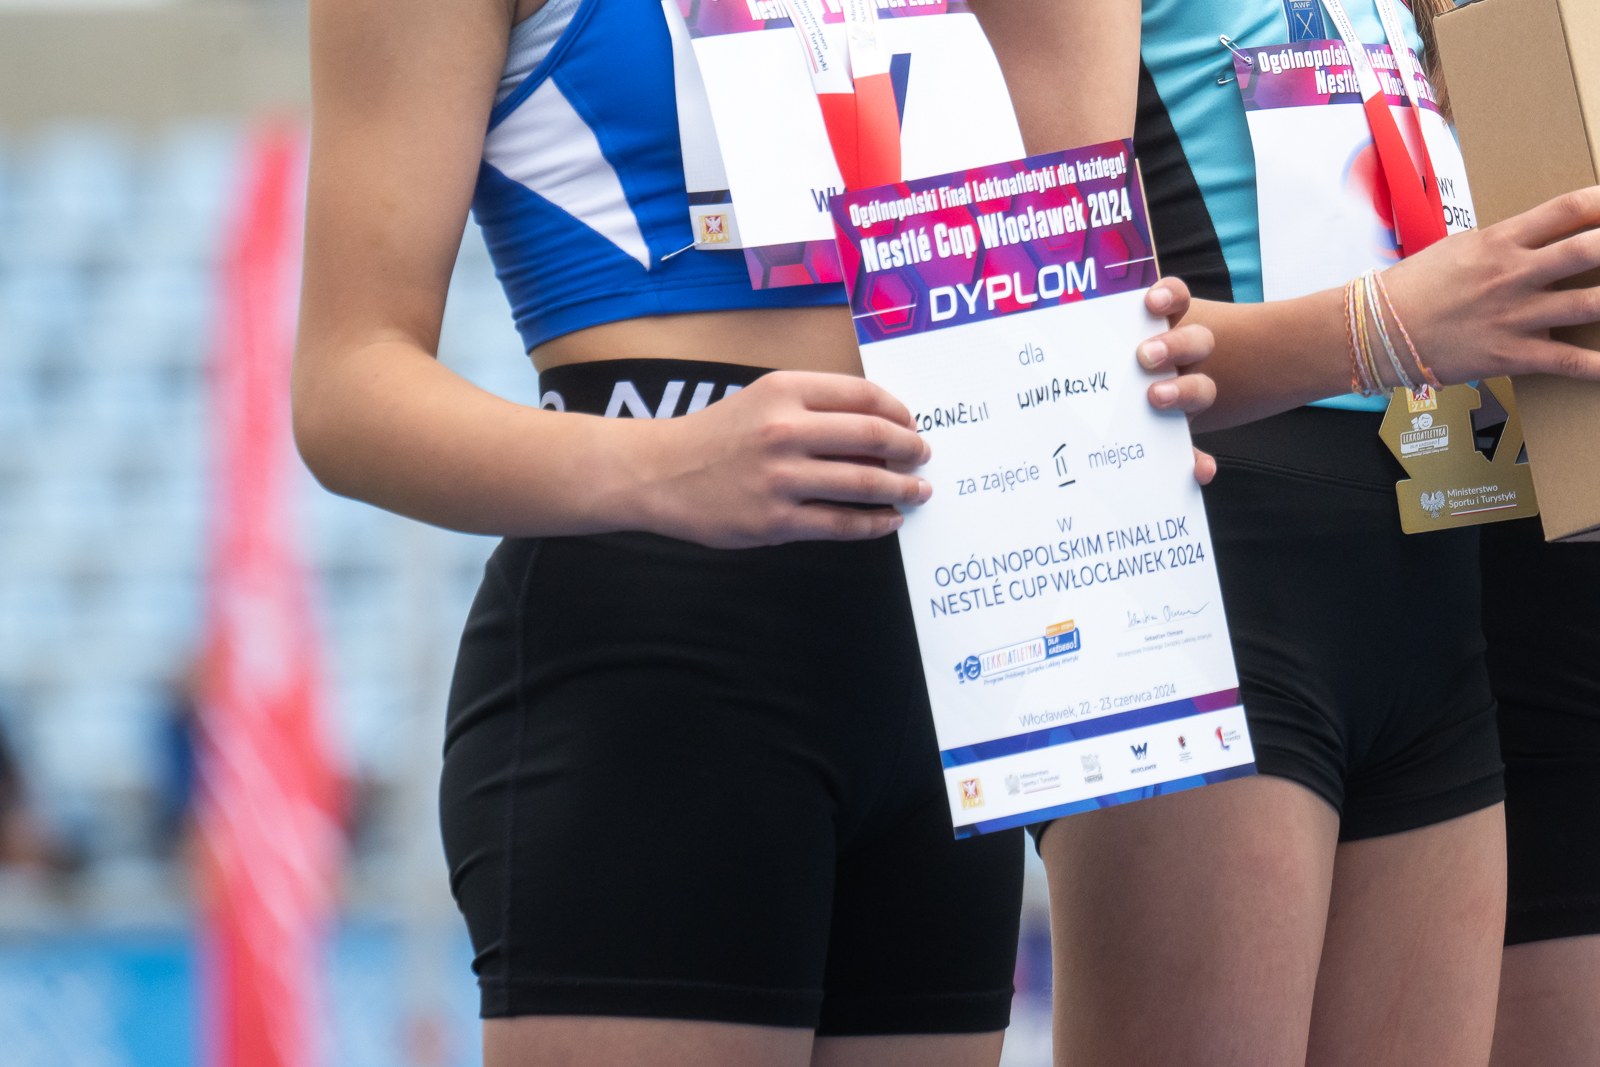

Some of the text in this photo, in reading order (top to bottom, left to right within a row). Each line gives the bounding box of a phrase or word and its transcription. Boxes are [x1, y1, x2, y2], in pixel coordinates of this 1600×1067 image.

[849, 193, 939, 227] Ogólnopolski
[939, 184, 973, 211] Finał
[973, 168, 1057, 202] Lekkoatletyki
[1057, 166, 1076, 186] dla
[1076, 152, 1127, 185] każdego!
[860, 187, 1132, 273] Nestlé Cup Włocławek 2024
[1442, 206, 1472, 229] ORZE
[929, 257, 1098, 323] DYPLOM
[1018, 343, 1045, 367] dla
[1017, 371, 1109, 409] WINIARCZYK
[1409, 400, 1435, 411] PZLA
[1403, 427, 1446, 443] LEKKOATLETYKA
[956, 479, 978, 496] za
[980, 462, 1040, 492] zajęcie
[1087, 440, 1146, 471] miejsca
[1447, 485, 1498, 498] Ministerstwo
[1448, 491, 1516, 509] Sportu i Turystyki
[934, 516, 1189, 588] OGÓLNOPOLSKIM FINAŁ LDK
[930, 542, 1205, 618] NESTLÉ CUP WŁOCŁAWEK 2024
[982, 643, 1042, 672] LEKKOATLETYKA
[1019, 684, 1176, 728] Włocławek, 22 23 czerwca 2024
